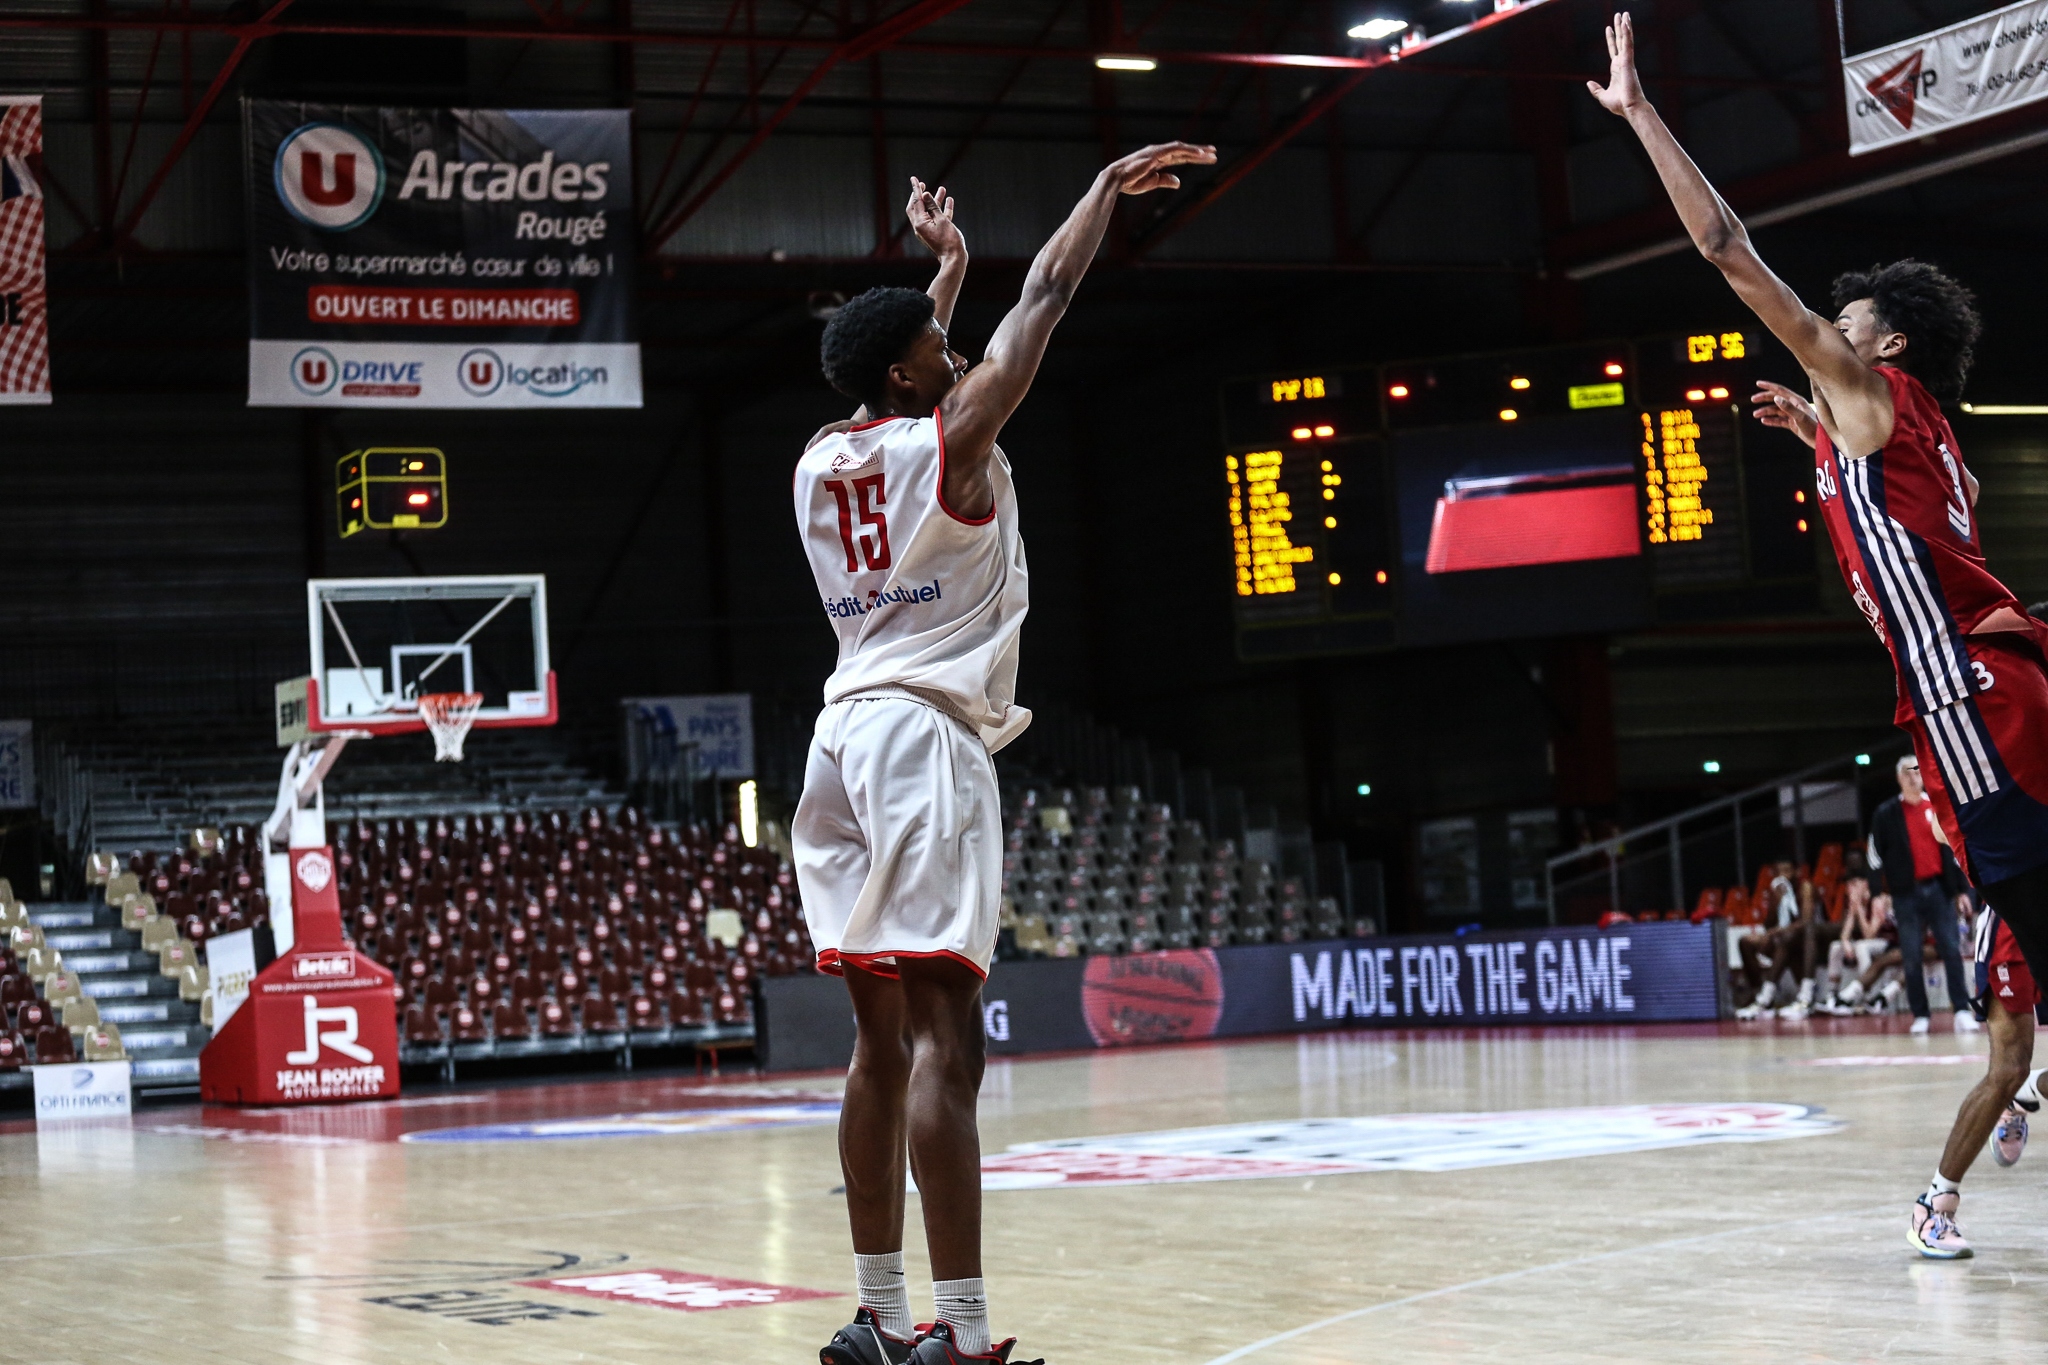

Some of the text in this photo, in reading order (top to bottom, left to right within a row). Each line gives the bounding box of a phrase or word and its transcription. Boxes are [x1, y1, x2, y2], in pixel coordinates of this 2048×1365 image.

[1907, 69, 1938, 100] TP
[301, 151, 356, 208] U
[398, 149, 610, 202] Arcades
[515, 209, 608, 246] Rougé
[270, 245, 330, 273] Votre
[335, 252, 467, 279] supermarché
[533, 253, 562, 277] de
[566, 253, 601, 277] ville
[315, 294, 574, 321] OUVERT LE DIMANCHE
[302, 359, 424, 386] U DRIVE
[468, 361, 608, 387] U location
[823, 472, 891, 573] 15
[1290, 947, 1398, 1022] MADE
[1400, 944, 1465, 1018] FOR
[1465, 941, 1531, 1016] THE
[1535, 936, 1636, 1015] GAME
[276, 1069, 318, 1091] JEAN
[283, 1082, 380, 1099] AUTOMOBILES
